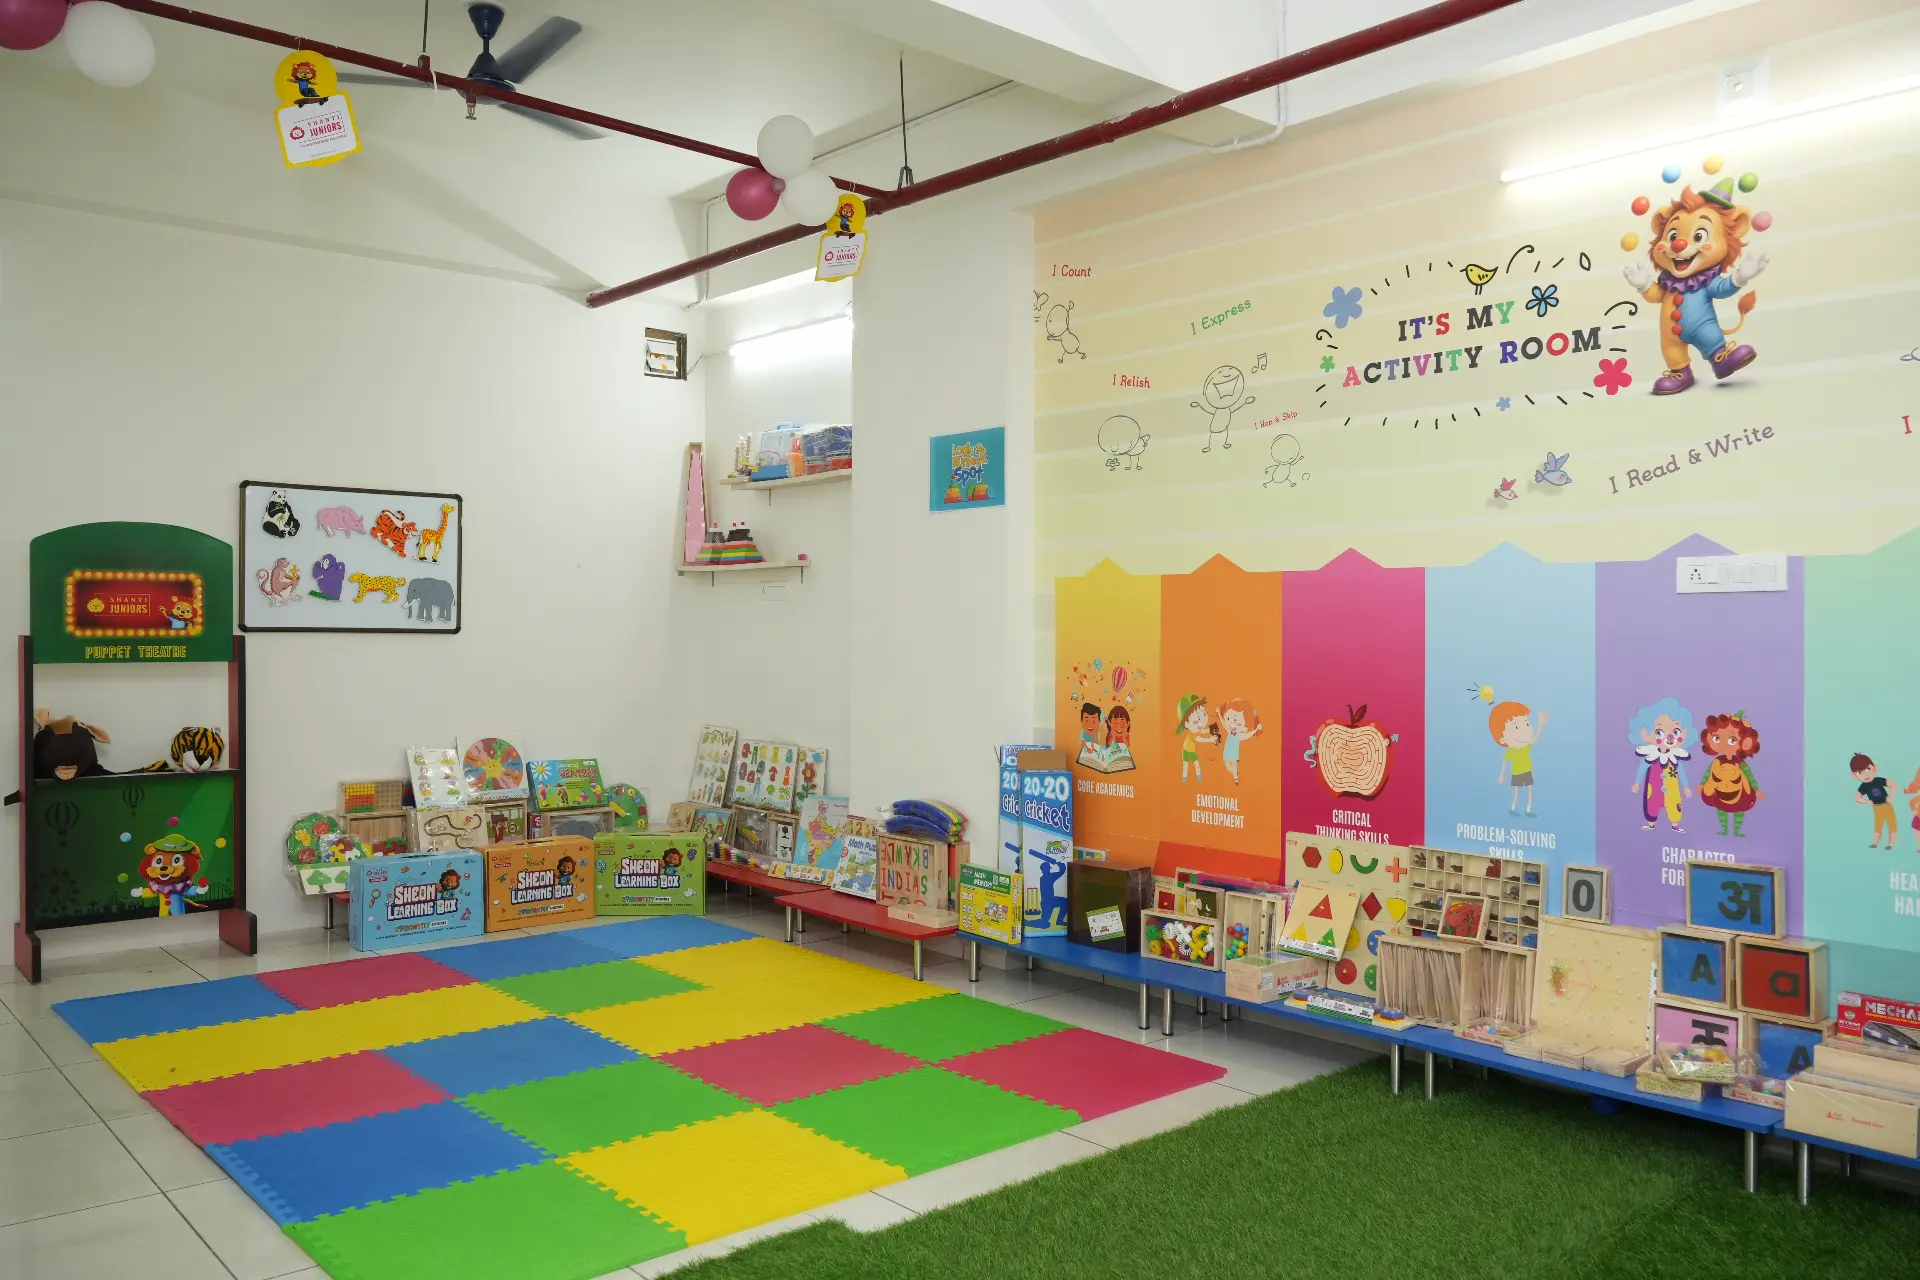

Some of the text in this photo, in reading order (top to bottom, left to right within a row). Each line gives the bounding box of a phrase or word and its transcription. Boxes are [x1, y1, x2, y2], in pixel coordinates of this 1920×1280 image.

[309, 121, 342, 137] JUNIORS
[1052, 264, 1091, 278] I Count
[1190, 299, 1251, 336] I Express
[1466, 300, 1515, 331] MY
[1342, 326, 1601, 388] ACTIVITY ROOM
[1112, 374, 1151, 389] I Relish
[1260, 419, 1273, 430] Hop
[1282, 411, 1298, 421] Skip
[1901, 414, 1913, 435] I
[1608, 425, 1775, 495] I Read & Write
[110, 604, 148, 614] JUNIORS
[85, 645, 187, 659] PUPPET THEATRE
[1024, 775, 1070, 803] 20-20
[1077, 779, 1134, 799] CORE ACADEMICS
[1196, 793, 1239, 812] EMOTIONAL
[1024, 799, 1070, 832] Cricket
[1191, 809, 1245, 829] DEVELOPMENT
[1332, 809, 1372, 828] CRITICAL
[1315, 824, 1357, 841] THINKING
[1456, 822, 1556, 849] PROBLEM-SOLVING
[848, 838, 865, 850] Math
[621, 858, 659, 875] SHEON
[517, 869, 554, 889] SHEON
[614, 873, 680, 889] LEARNING BOX
[394, 884, 437, 904] SHEON
[511, 884, 574, 904] LEARNING BOX
[1717, 880, 1764, 925] अ
[387, 898, 458, 920] LEARNING BOX
[1689, 953, 1716, 986] A
[1865, 1001, 1920, 1021] MECHA
[1786, 1045, 1813, 1075] A
